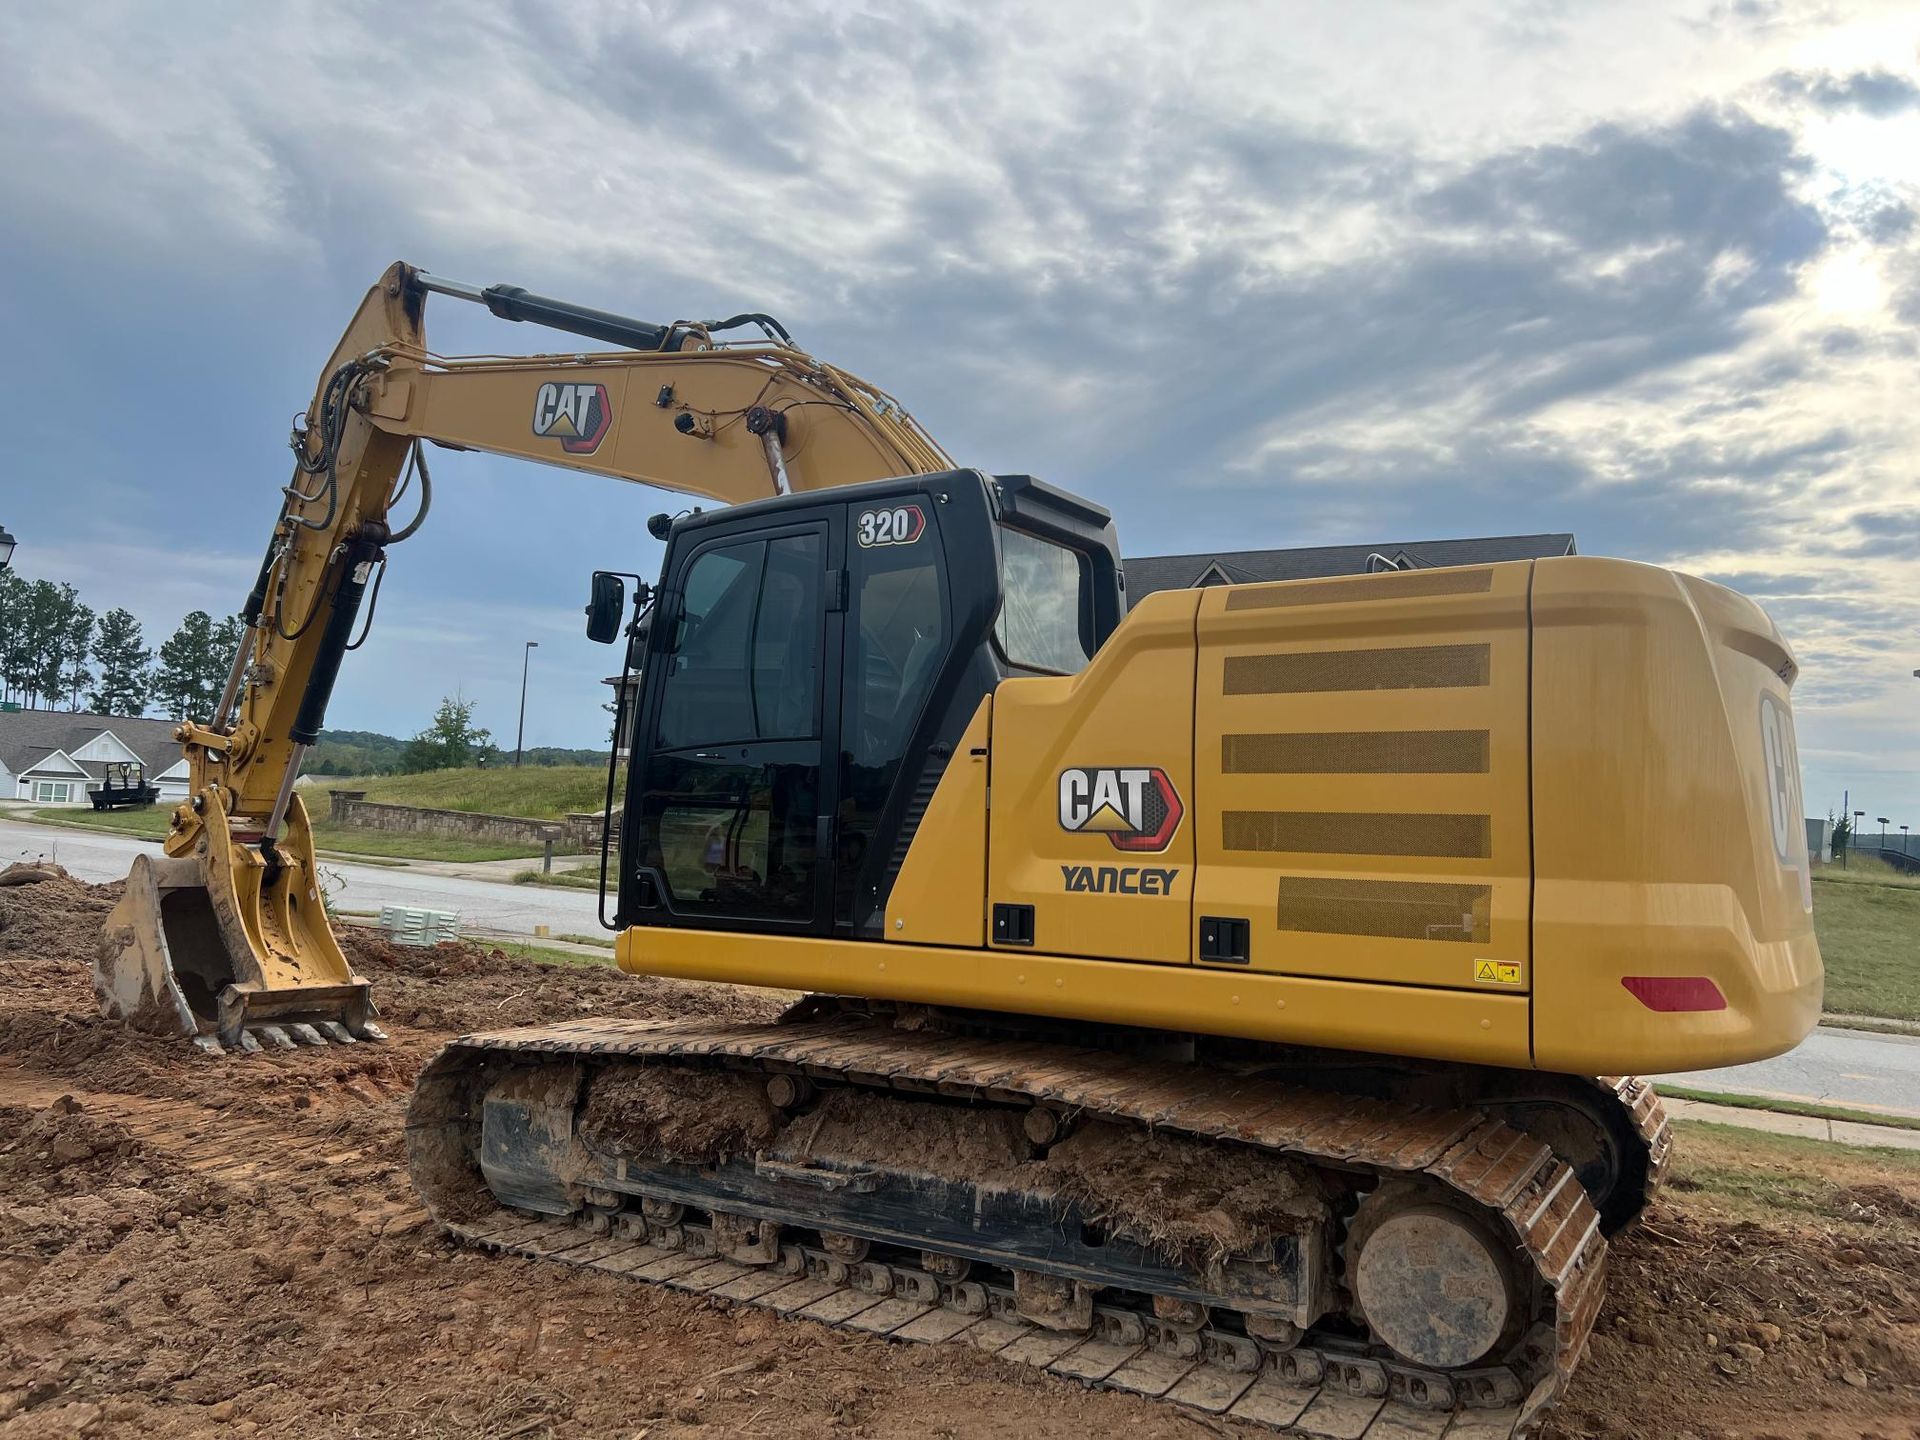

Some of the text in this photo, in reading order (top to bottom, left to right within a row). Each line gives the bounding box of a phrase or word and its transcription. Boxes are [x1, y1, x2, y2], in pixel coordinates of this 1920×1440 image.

[533, 383, 597, 437] CAT
[860, 508, 909, 545] 320
[1060, 768, 1150, 832] CAT
[1761, 698, 1803, 858] CA
[1060, 865, 1180, 896] YANCEY
